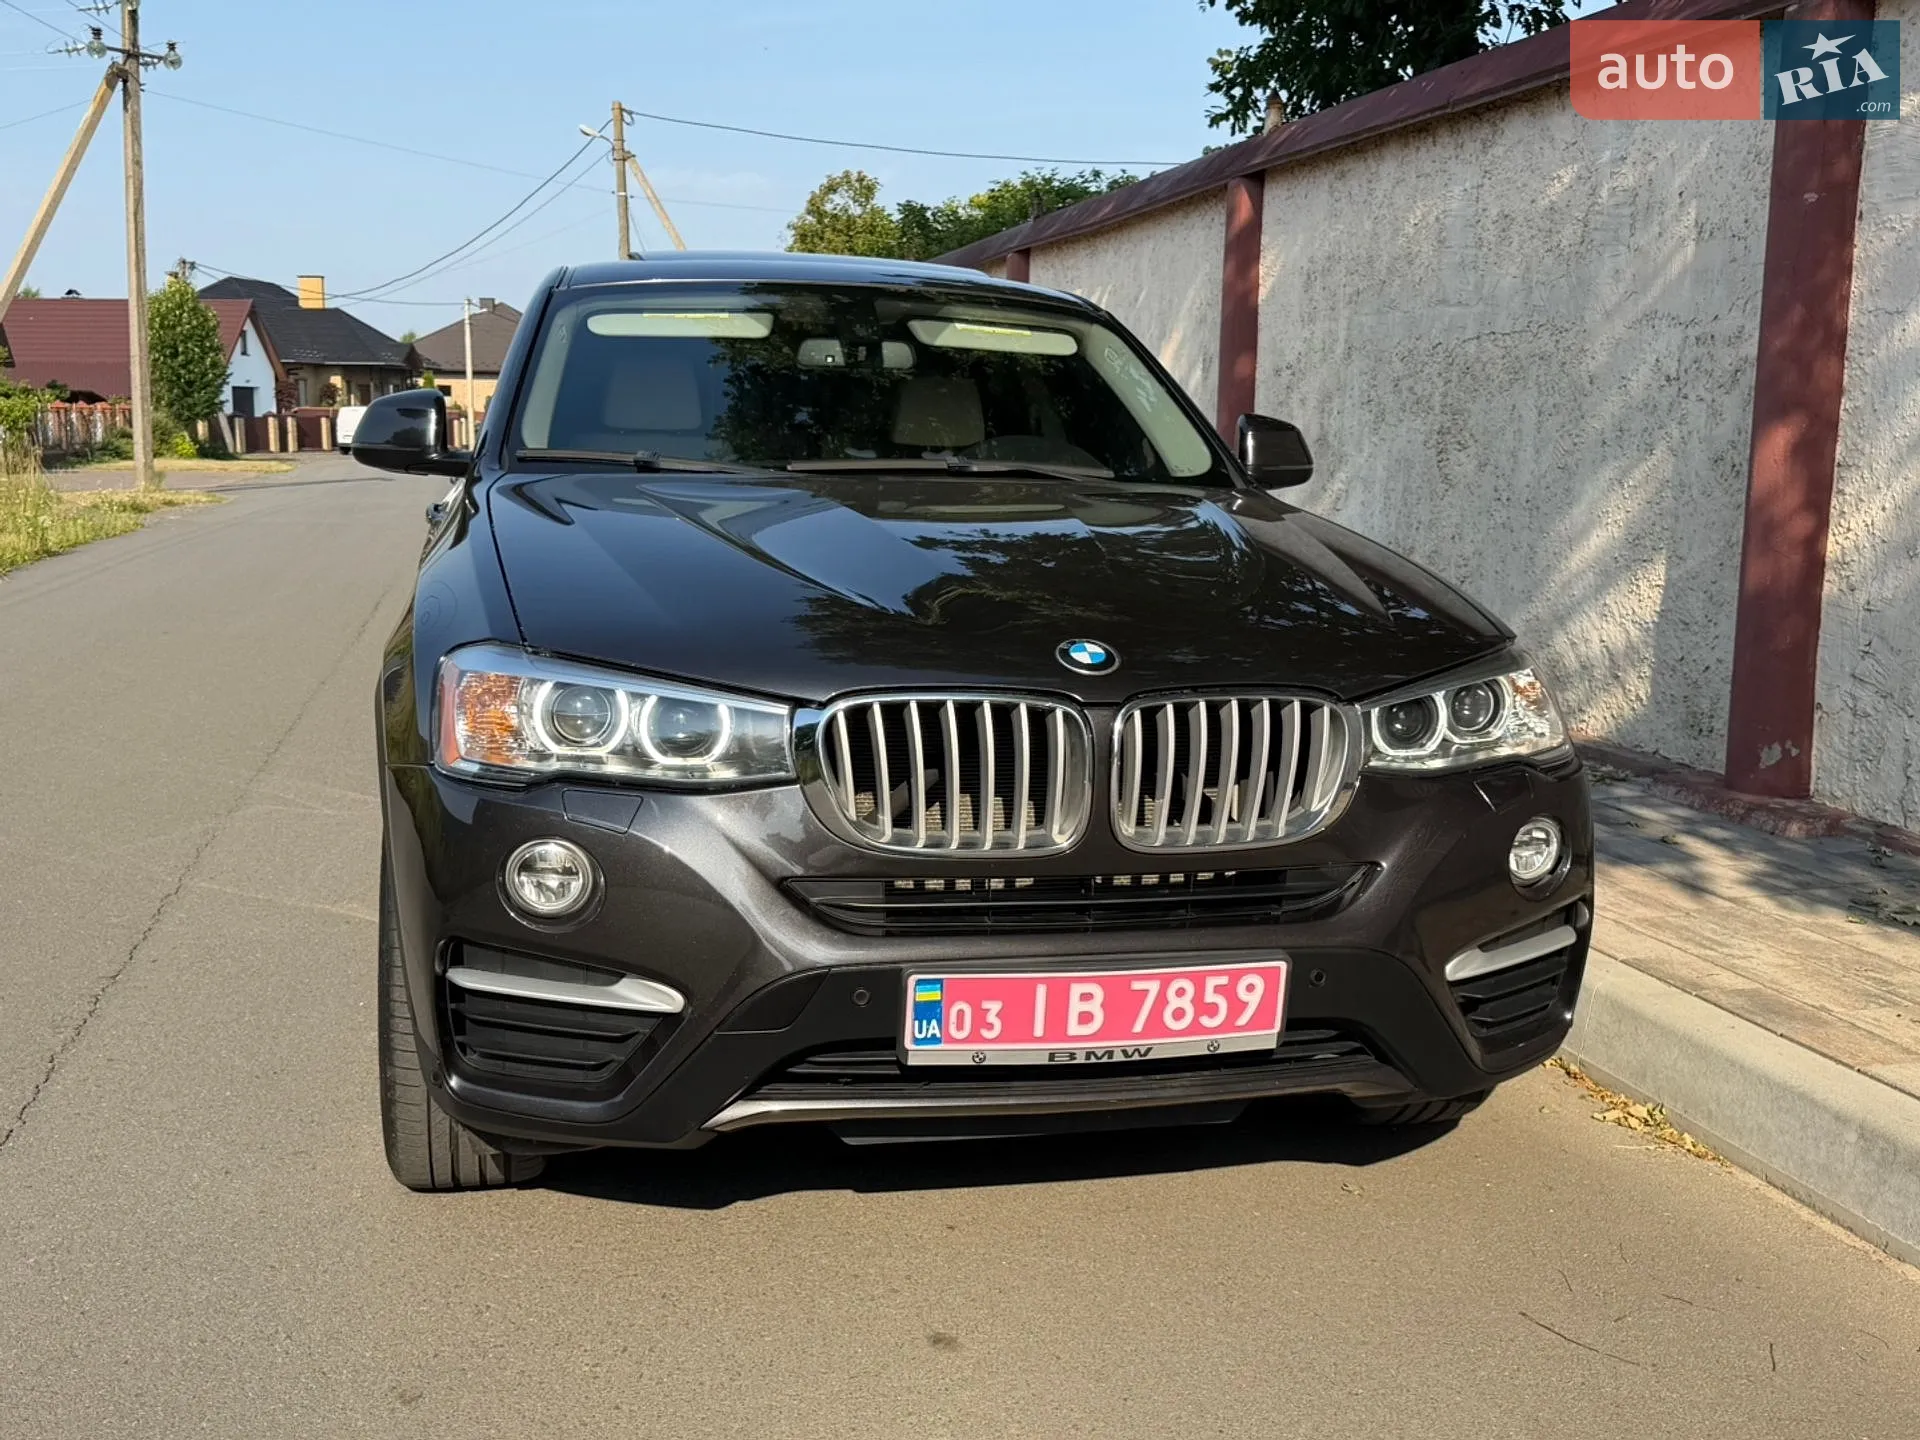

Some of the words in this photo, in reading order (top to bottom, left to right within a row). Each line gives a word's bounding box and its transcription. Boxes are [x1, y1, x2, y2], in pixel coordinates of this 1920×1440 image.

[949, 1001, 1003, 1040] 03
[1033, 983, 1104, 1038] IB
[1131, 973, 1265, 1033] 7859
[914, 1020, 941, 1039] UA
[1048, 1047, 1153, 1063] BMW
